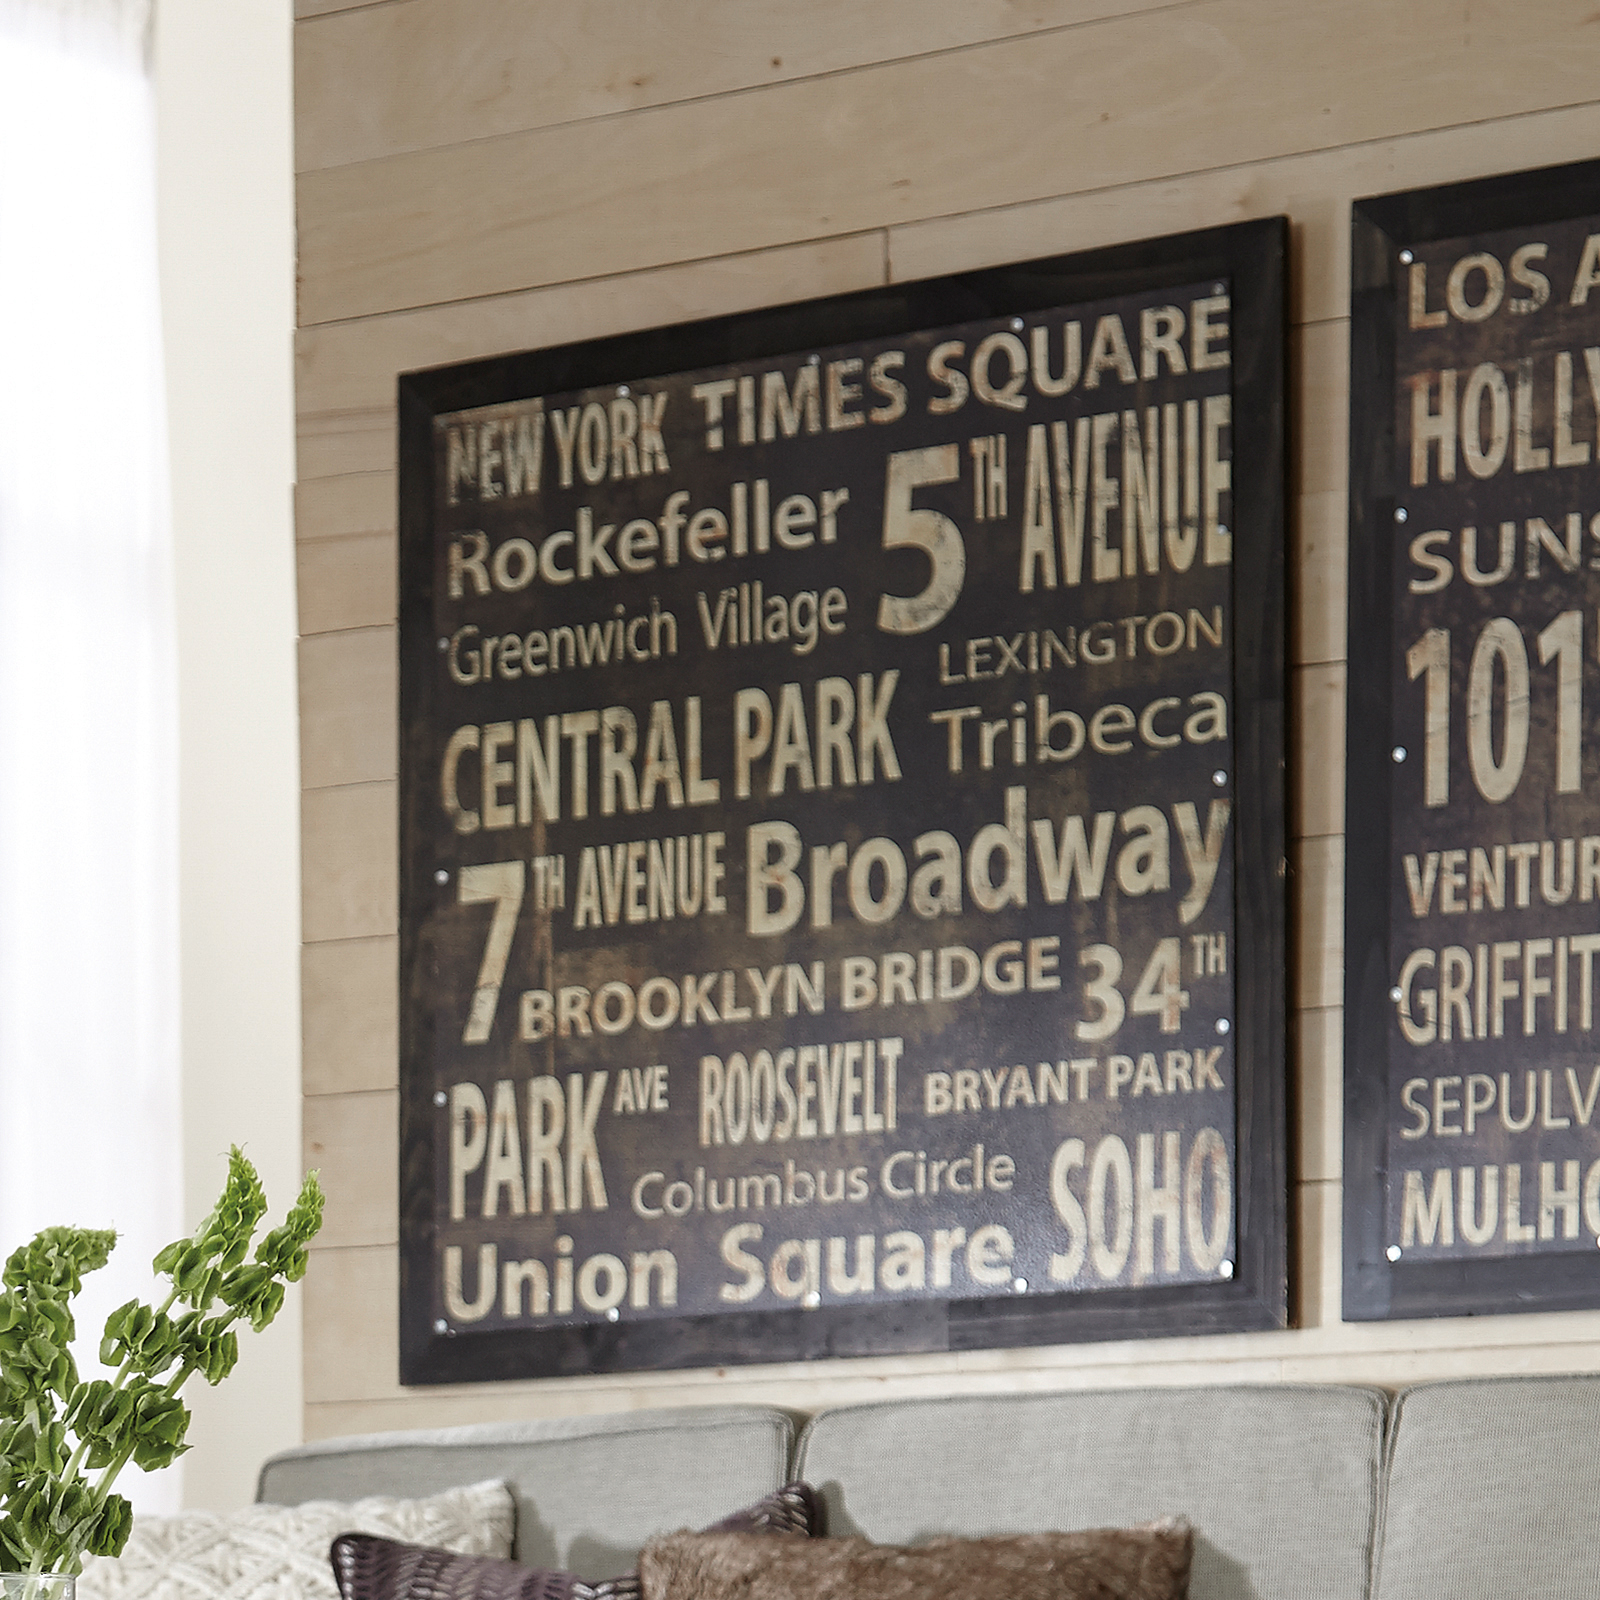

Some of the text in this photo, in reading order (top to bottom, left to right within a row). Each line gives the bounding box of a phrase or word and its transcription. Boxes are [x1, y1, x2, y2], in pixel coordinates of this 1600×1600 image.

[1408, 242, 1552, 331] LOS
[694, 295, 1232, 450] TIMES SQUARE
[446, 393, 671, 504] NEW YORK
[1019, 394, 1232, 592] AVENUE
[448, 479, 849, 597] Rockefeller
[1408, 512, 1600, 595] SUN
[447, 581, 849, 685] Greenwich Village
[939, 606, 1223, 684] LEXINGTON
[441, 669, 903, 832] CENTRAL PARK
[929, 691, 1230, 773] Tribeca
[1405, 609, 1584, 808] 101
[573, 832, 726, 930] AVENUE
[745, 788, 1231, 938] Broadway
[518, 935, 1061, 1043] BROOKLYN BRIDGE
[1400, 934, 1600, 1045] GRIFFIT
[699, 1037, 904, 1147] ROOSEVELT
[924, 1045, 1227, 1117] BRYANT PARK
[1400, 1065, 1600, 1141] SEPULV
[449, 1065, 670, 1222] PARK AVE
[631, 1143, 1016, 1220] Columbus Circle
[1048, 1126, 1234, 1283] SOHO
[442, 1221, 1016, 1323] Union Square
